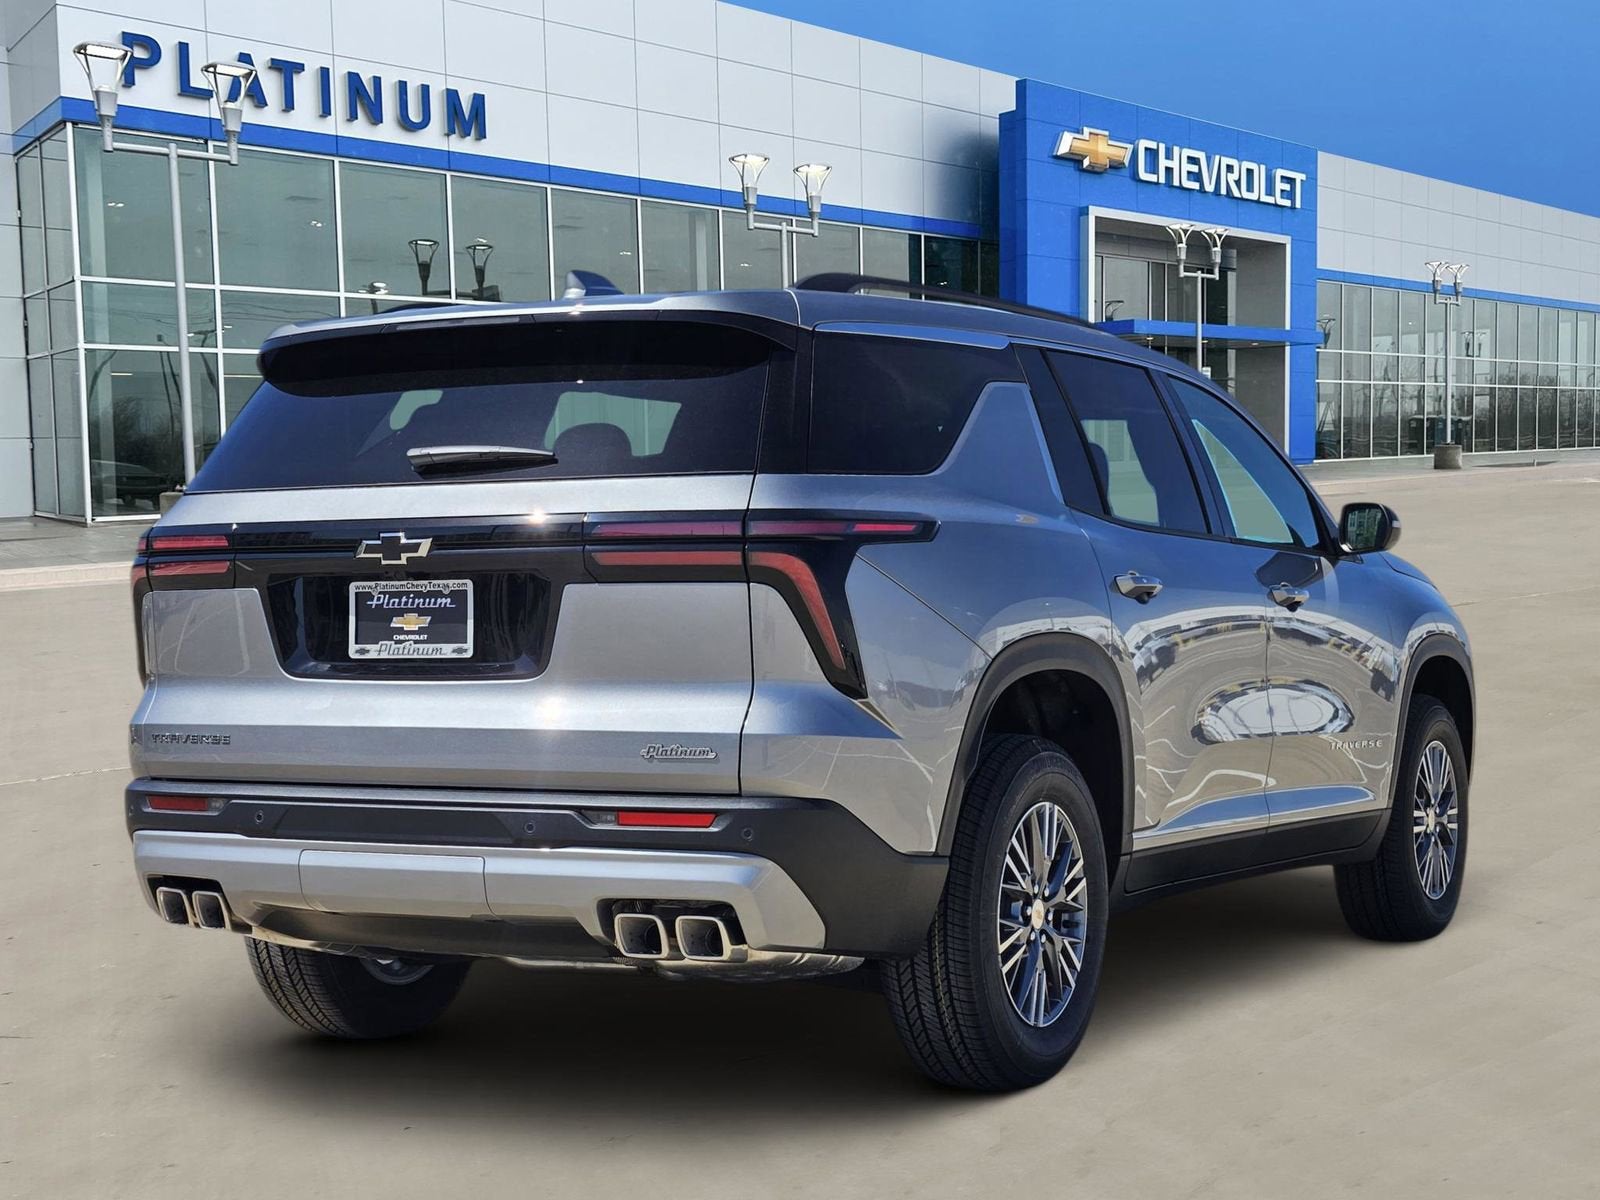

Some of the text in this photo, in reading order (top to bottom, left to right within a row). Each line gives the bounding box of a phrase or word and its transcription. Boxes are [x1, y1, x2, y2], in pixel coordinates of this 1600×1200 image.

[121, 31, 487, 140] PLATINUM
[1136, 138, 1307, 209] CHEVROLET
[354, 581, 468, 592] www.PlatinumChevyTexas.com
[366, 593, 456, 609] Platinum
[374, 641, 447, 657] Platinum
[151, 733, 231, 745] TRAVERSE
[1330, 740, 1383, 750] TRAVERSE
[640, 744, 718, 759] Platinum
